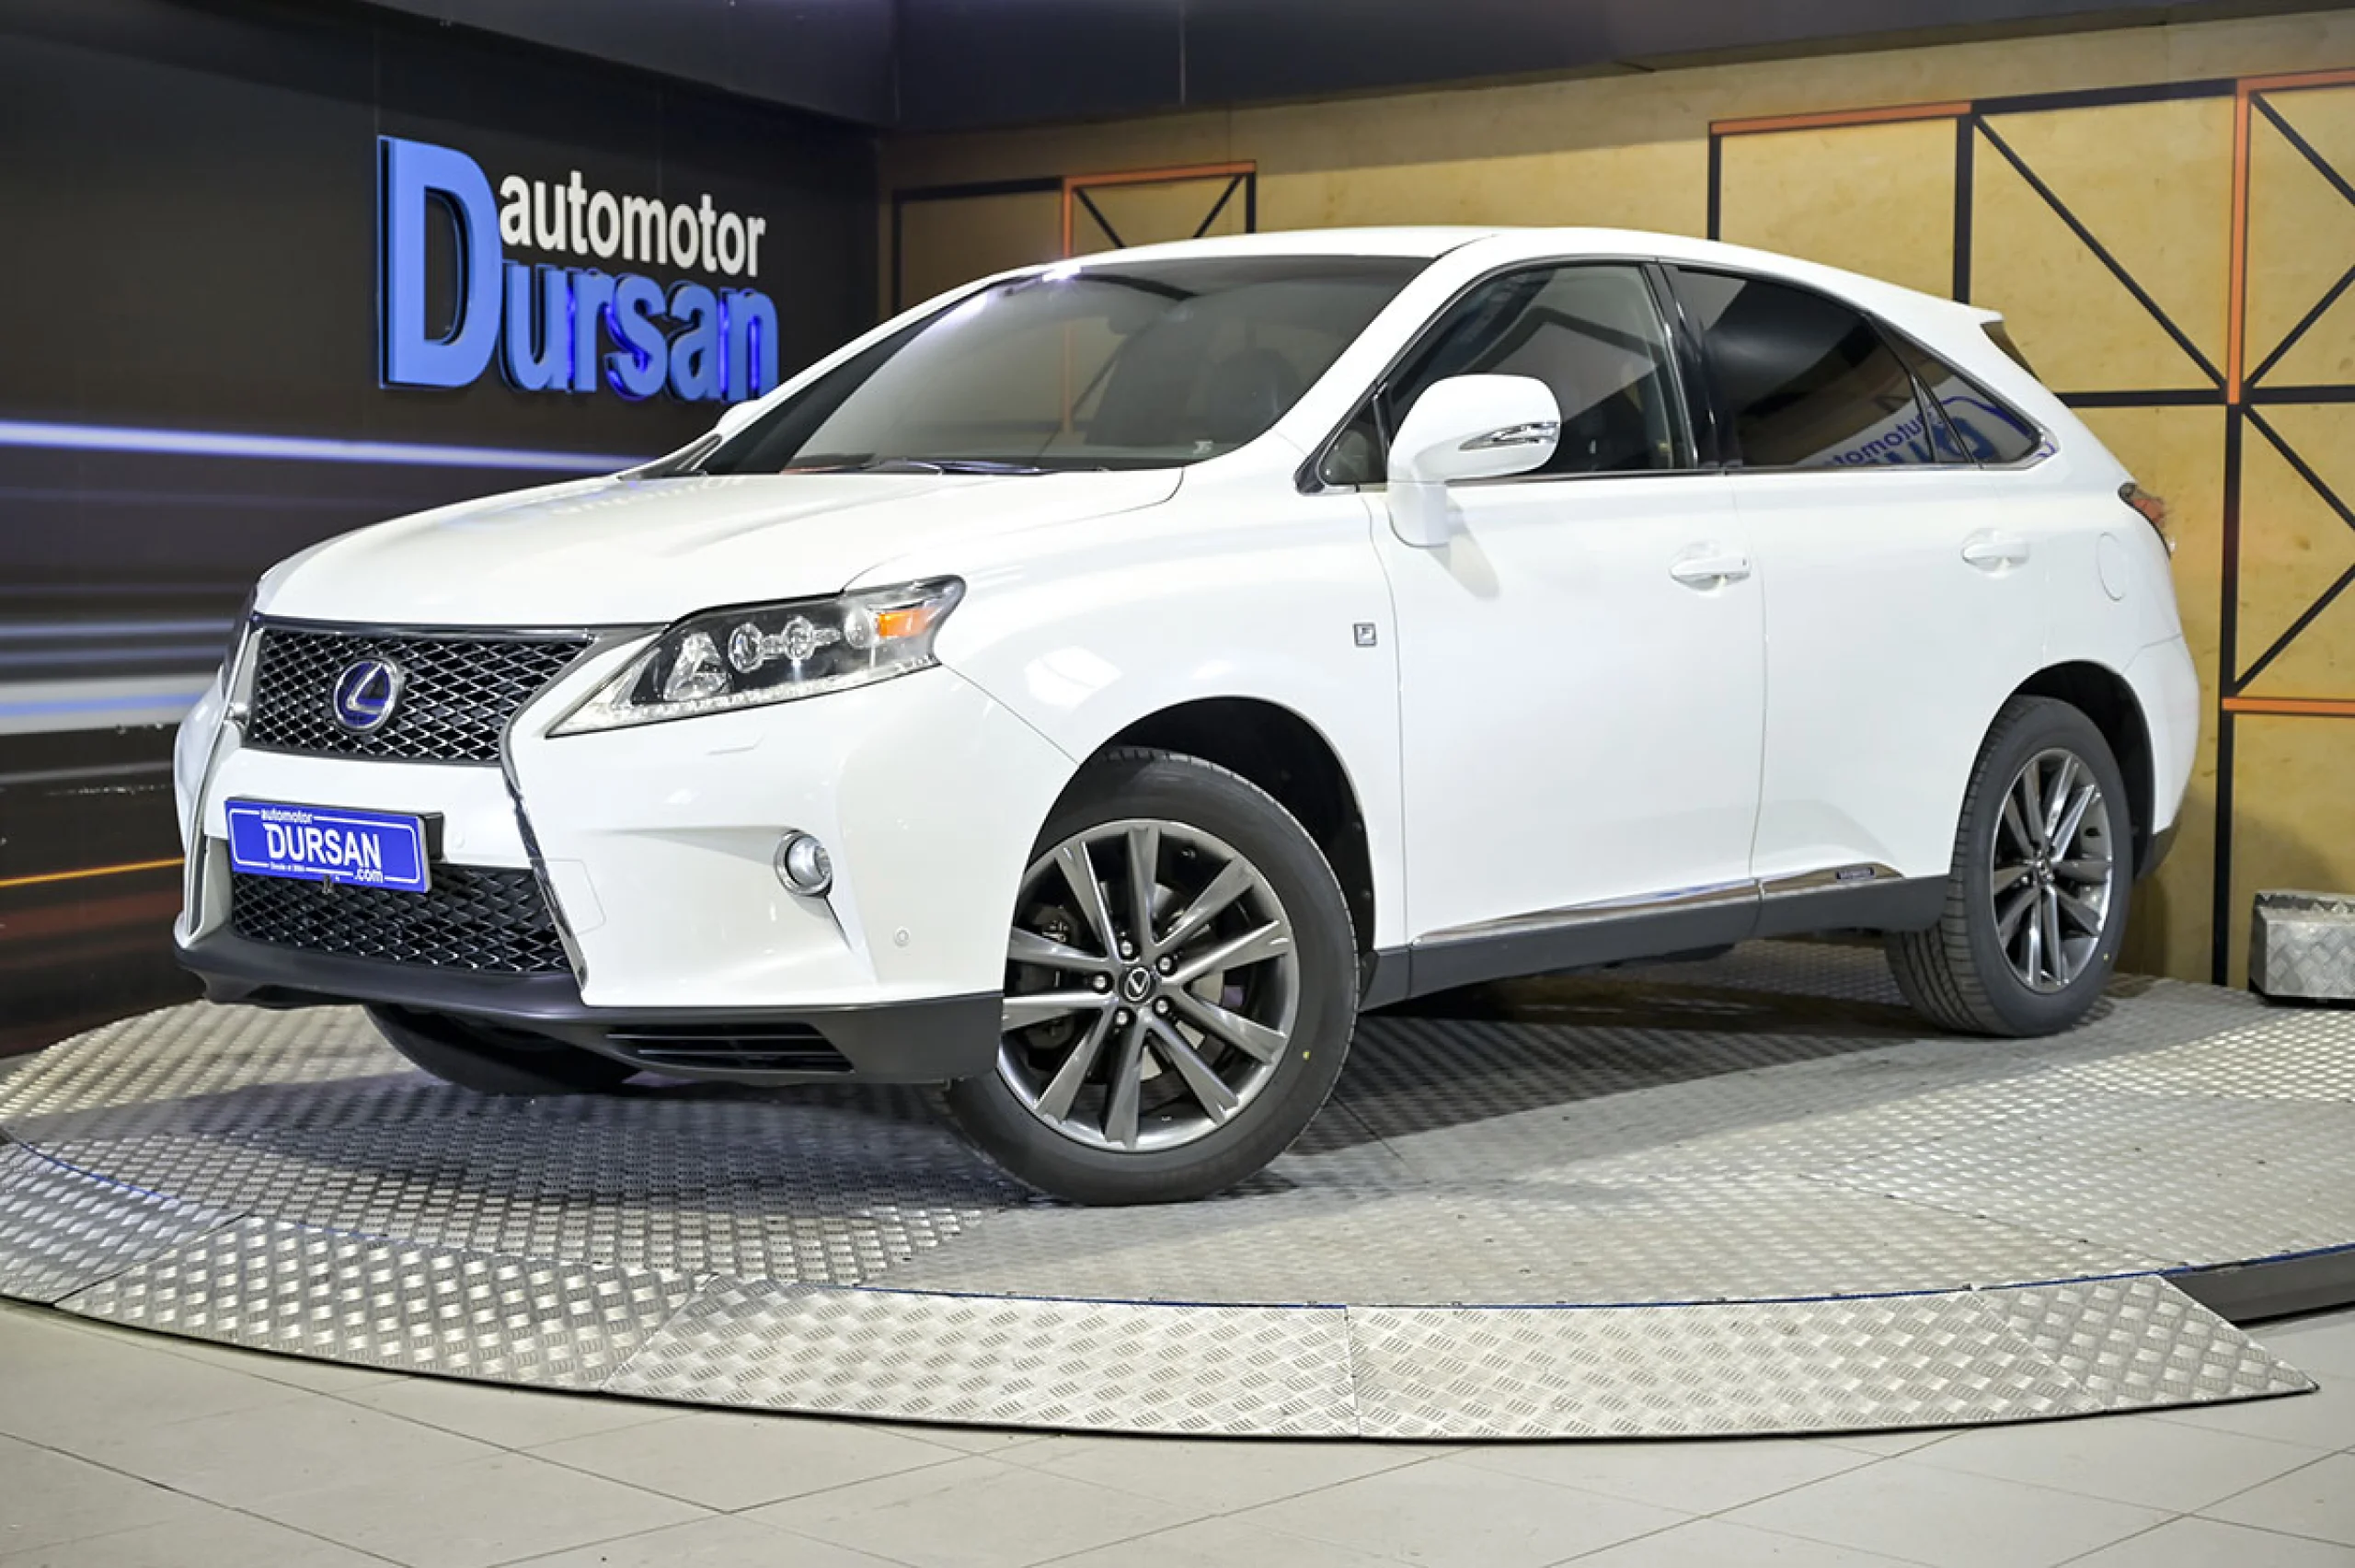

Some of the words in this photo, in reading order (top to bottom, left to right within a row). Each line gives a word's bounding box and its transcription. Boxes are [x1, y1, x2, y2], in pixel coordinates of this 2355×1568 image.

[500, 170, 766, 277] automotor
[377, 135, 779, 403] Dursan
[260, 808, 313, 824] automotor
[263, 822, 382, 870] DURSAN
[354, 868, 384, 884] .com
